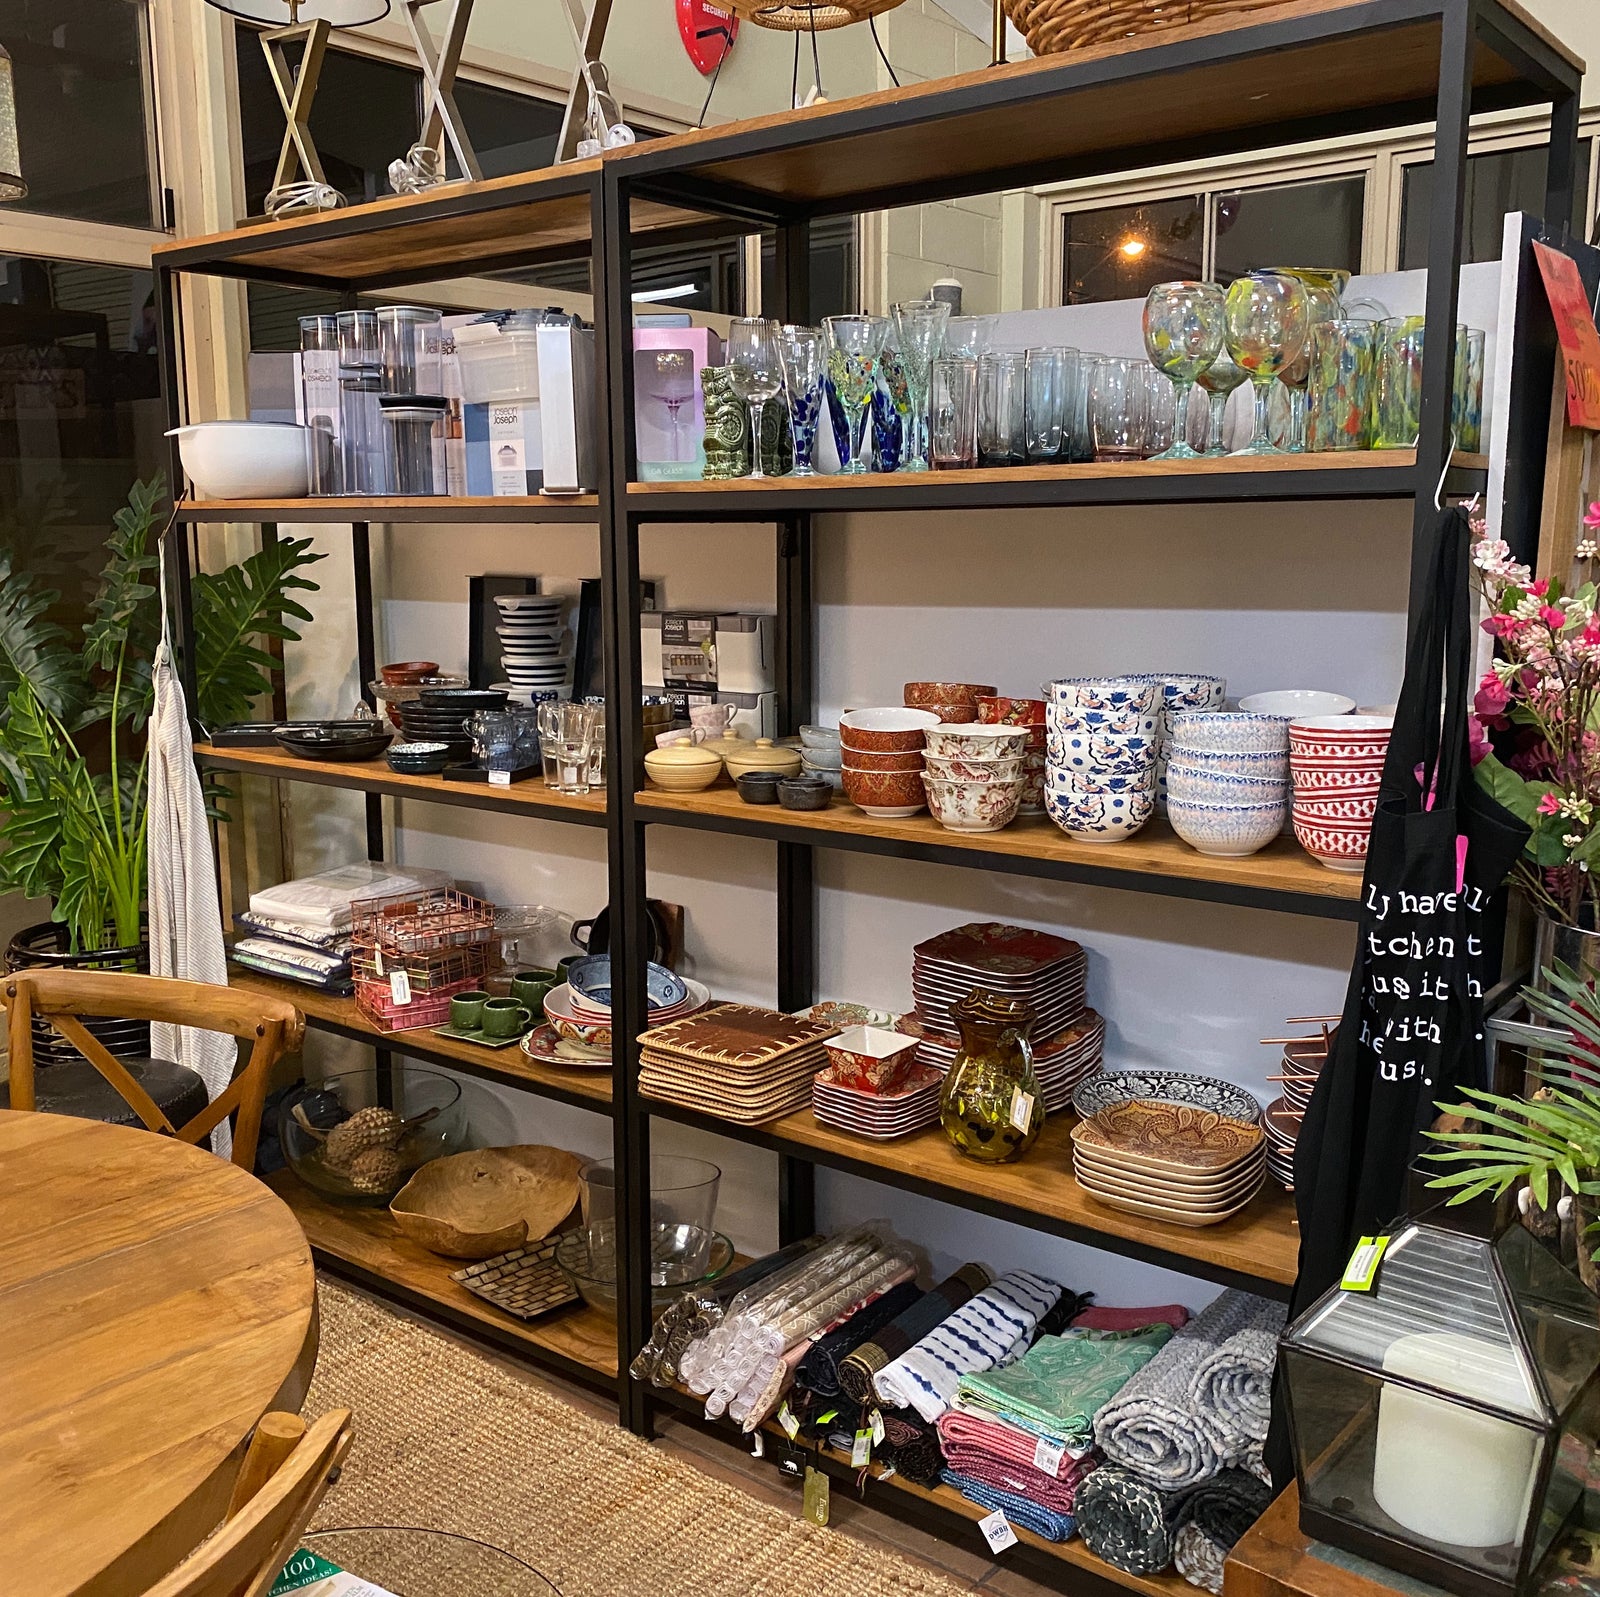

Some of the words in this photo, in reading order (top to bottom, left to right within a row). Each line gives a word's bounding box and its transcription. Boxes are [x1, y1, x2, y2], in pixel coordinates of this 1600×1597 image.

[493, 414, 518, 425] Joseph
[1419, 971, 1449, 1001] it
[282, 1556, 316, 1580] 100
[302, 1568, 333, 1585] IDEAS!
